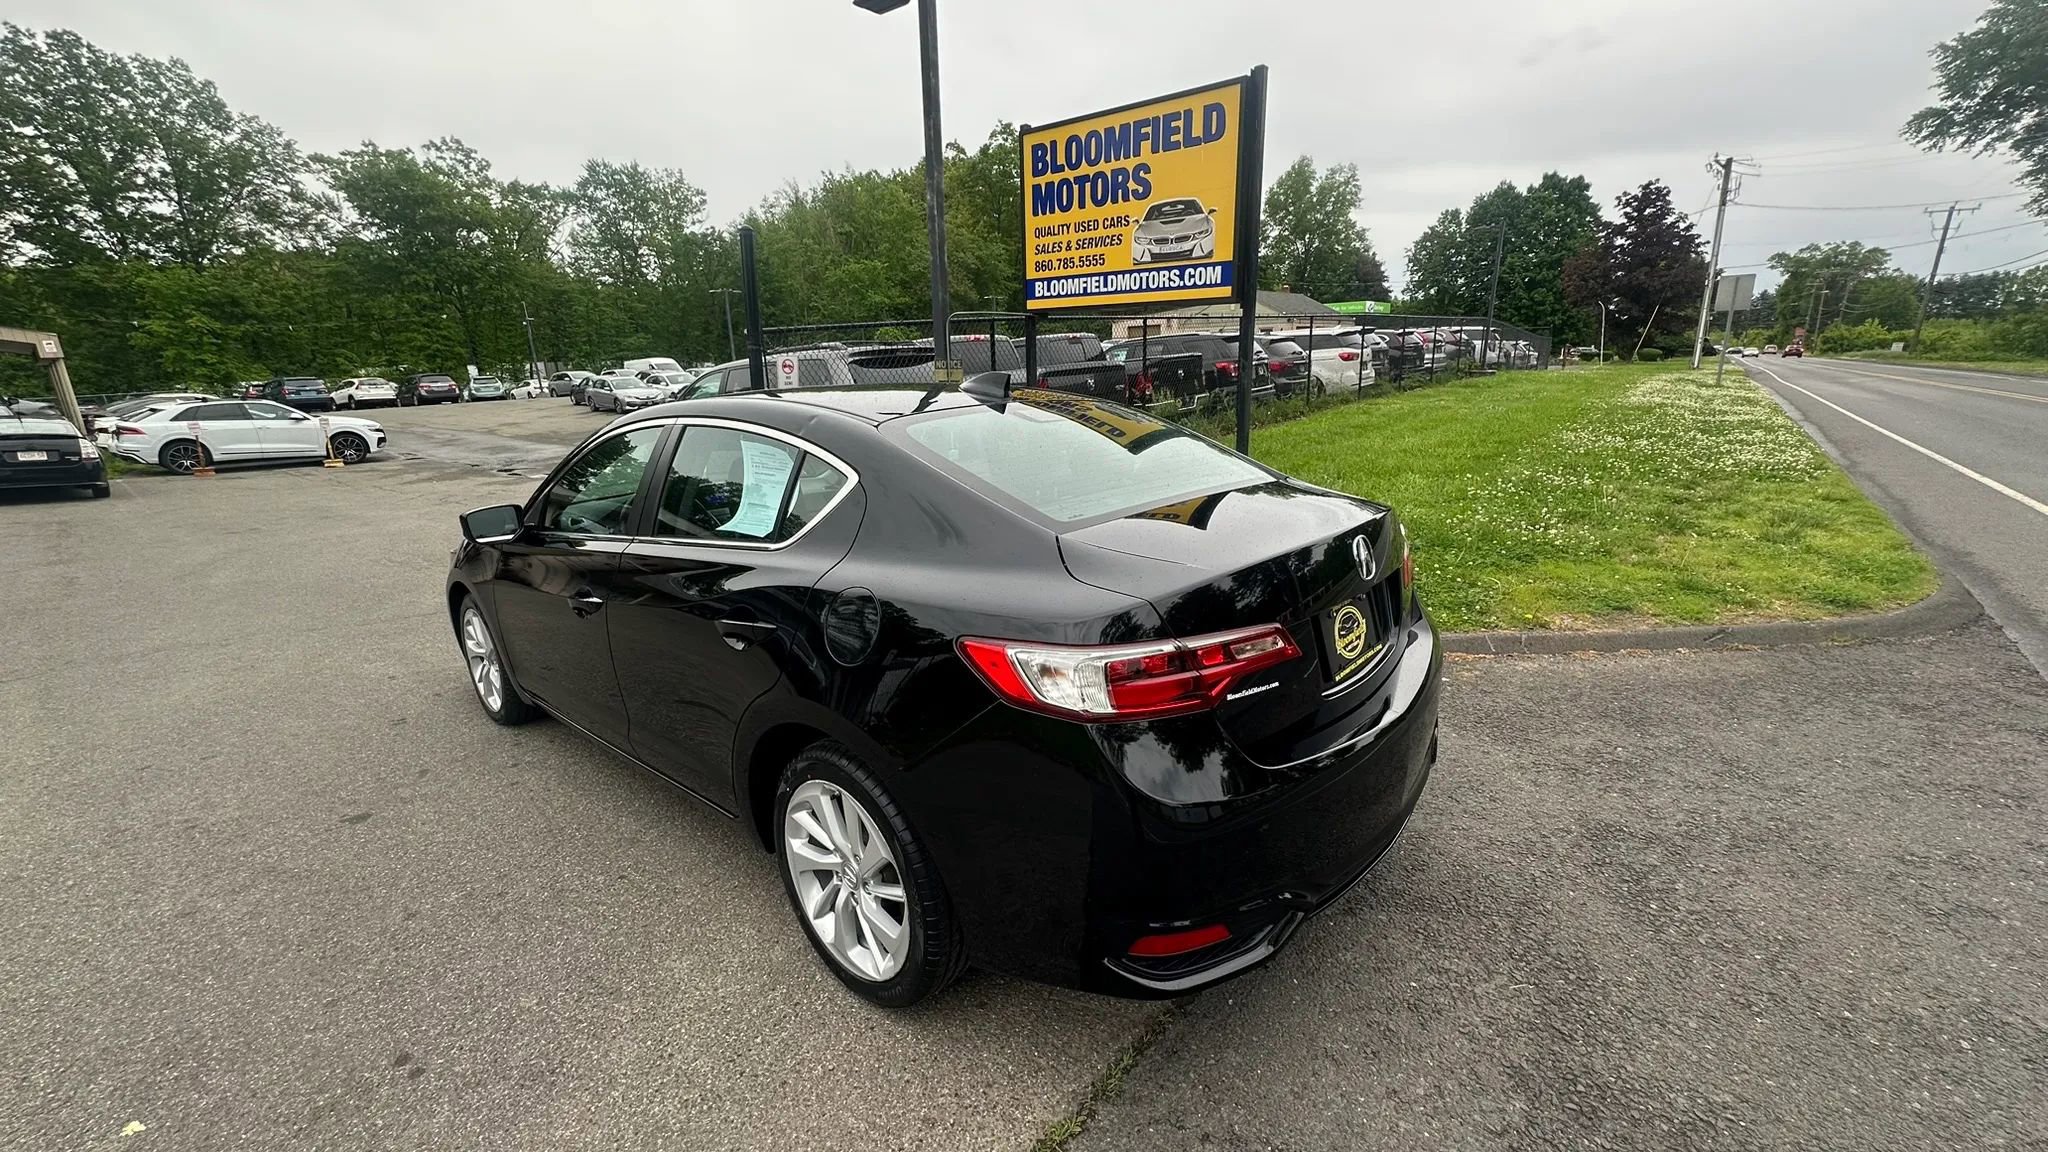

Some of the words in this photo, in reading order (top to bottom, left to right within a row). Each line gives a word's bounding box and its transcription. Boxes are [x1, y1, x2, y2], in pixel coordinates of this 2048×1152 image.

[1031, 102, 1226, 177] BLOOMFIELD
[1032, 162, 1152, 216] MOTORS
[1034, 223, 1071, 239] QUALITY
[1074, 219, 1099, 233] USED
[1102, 215, 1130, 229] CARS
[1034, 241, 1063, 255] SALES
[1065, 240, 1072, 251] &
[1075, 233, 1123, 250] SERVICES
[1034, 253, 1105, 272] 860.785.5555
[1034, 266, 1222, 297] BLOOMFIELDMOTORS.COM
[935, 360, 962, 369] NOICE
